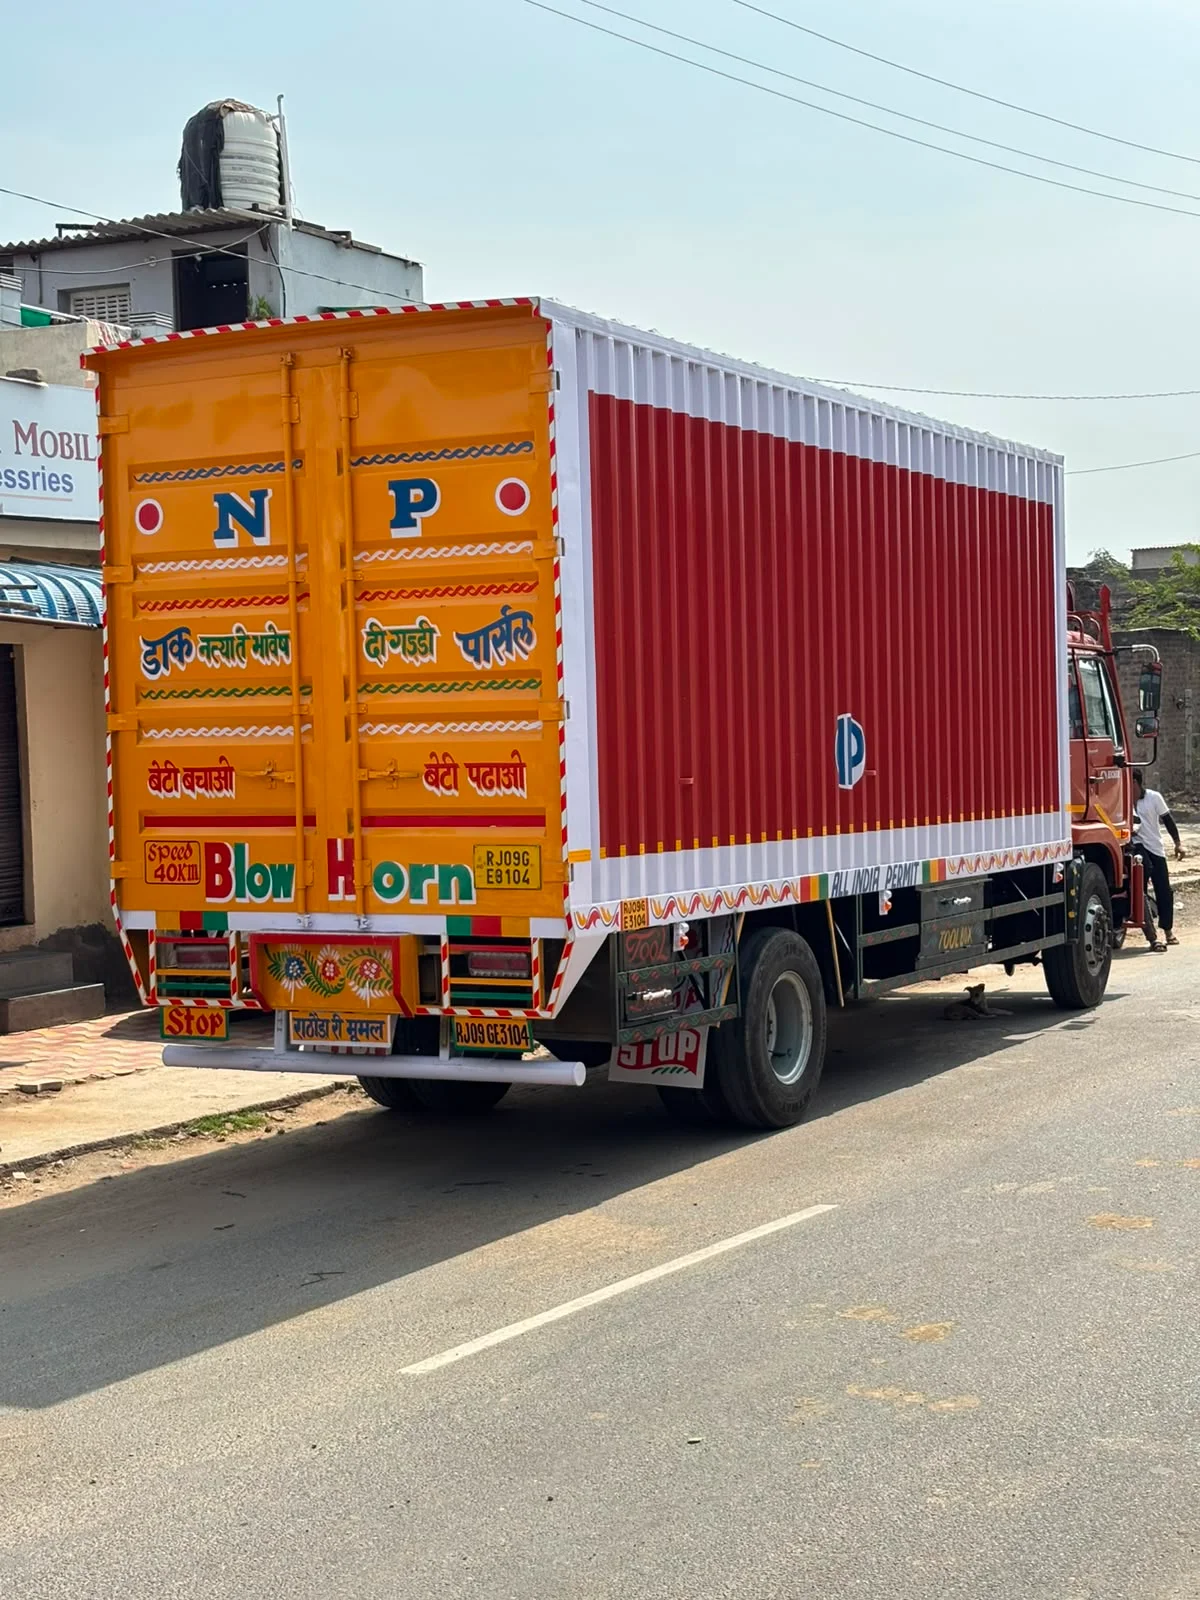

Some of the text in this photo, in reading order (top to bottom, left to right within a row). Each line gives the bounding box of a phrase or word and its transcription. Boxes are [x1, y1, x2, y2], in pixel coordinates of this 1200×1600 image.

[0, 465, 74, 493] ssries
[213, 477, 441, 548] N P
[139, 625, 196, 680] डाक
[453, 604, 537, 670] पार्सल
[147, 755, 235, 800] बेटी बचाओ
[422, 751, 460, 797] बेटी
[147, 842, 193, 863] Speed
[204, 842, 295, 903] Blow
[486, 850, 530, 867] RJ09G
[831, 861, 920, 897] ALL INDIA PERMIT
[165, 1007, 224, 1036] Stop
